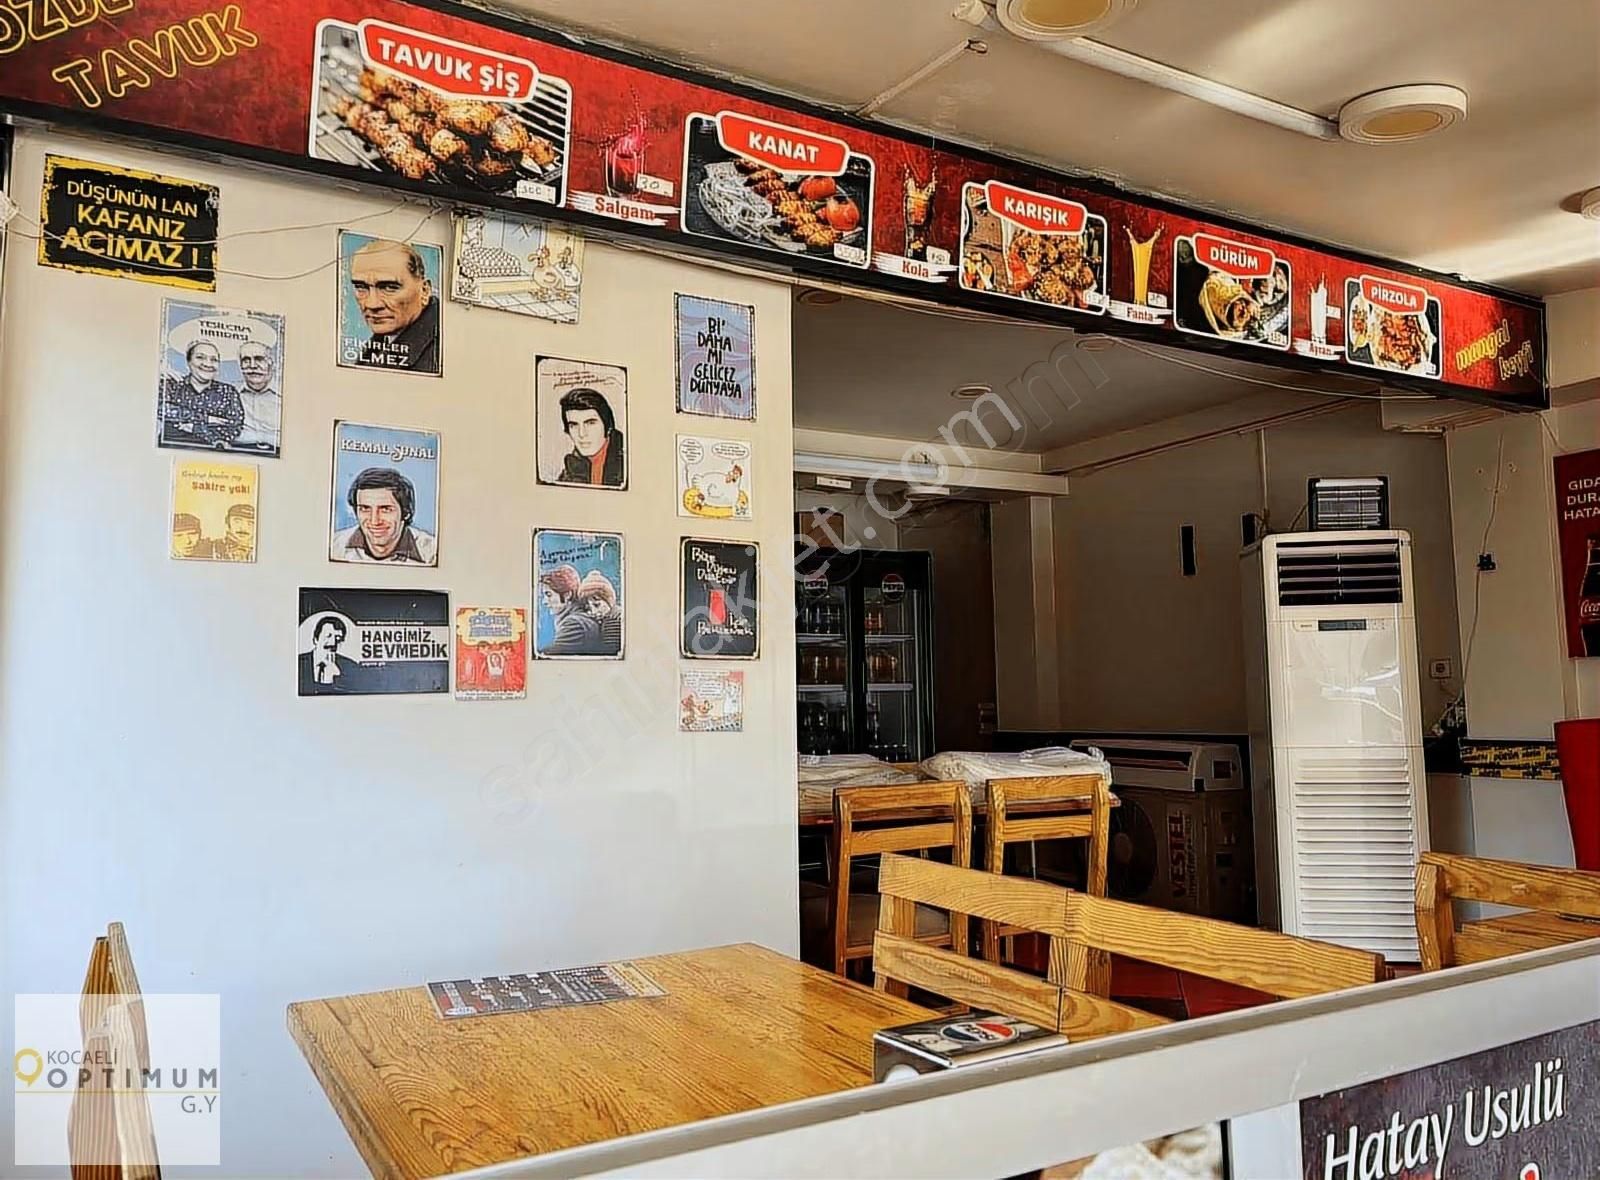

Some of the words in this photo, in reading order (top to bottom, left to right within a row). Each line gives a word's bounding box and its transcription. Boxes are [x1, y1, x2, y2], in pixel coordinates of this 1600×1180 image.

[52, 5, 258, 108] TAVUK
[378, 38, 473, 82] TAVUK
[478, 63, 521, 97] ŞİŞ
[749, 130, 820, 164] KANAT
[67, 180, 157, 211] DÜŞÜNÜN
[162, 198, 198, 218] LAN
[1004, 196, 1069, 227] KARIŞIK
[78, 203, 186, 241] KAFANIZ
[902, 260, 929, 278] Kola
[1210, 244, 1259, 271] DÜRÜM
[1371, 283, 1417, 308] PİRZOLA
[1127, 307, 1154, 321] Fanta
[697, 331, 732, 352] DAHA
[1456, 318, 1511, 371] mangal
[344, 346, 409, 367] ÖLMEZ
[707, 348, 722, 365] MI
[341, 438, 391, 455] KEMAL
[1567, 492, 1600, 506] DUR
[361, 628, 431, 643] HANGİMİZ
[361, 640, 448, 658] SEVMEDİK
[1168, 810, 1186, 898] VESTEL
[1323, 1103, 1455, 1180] Hatay
[1464, 1057, 1565, 1147] Usulü
